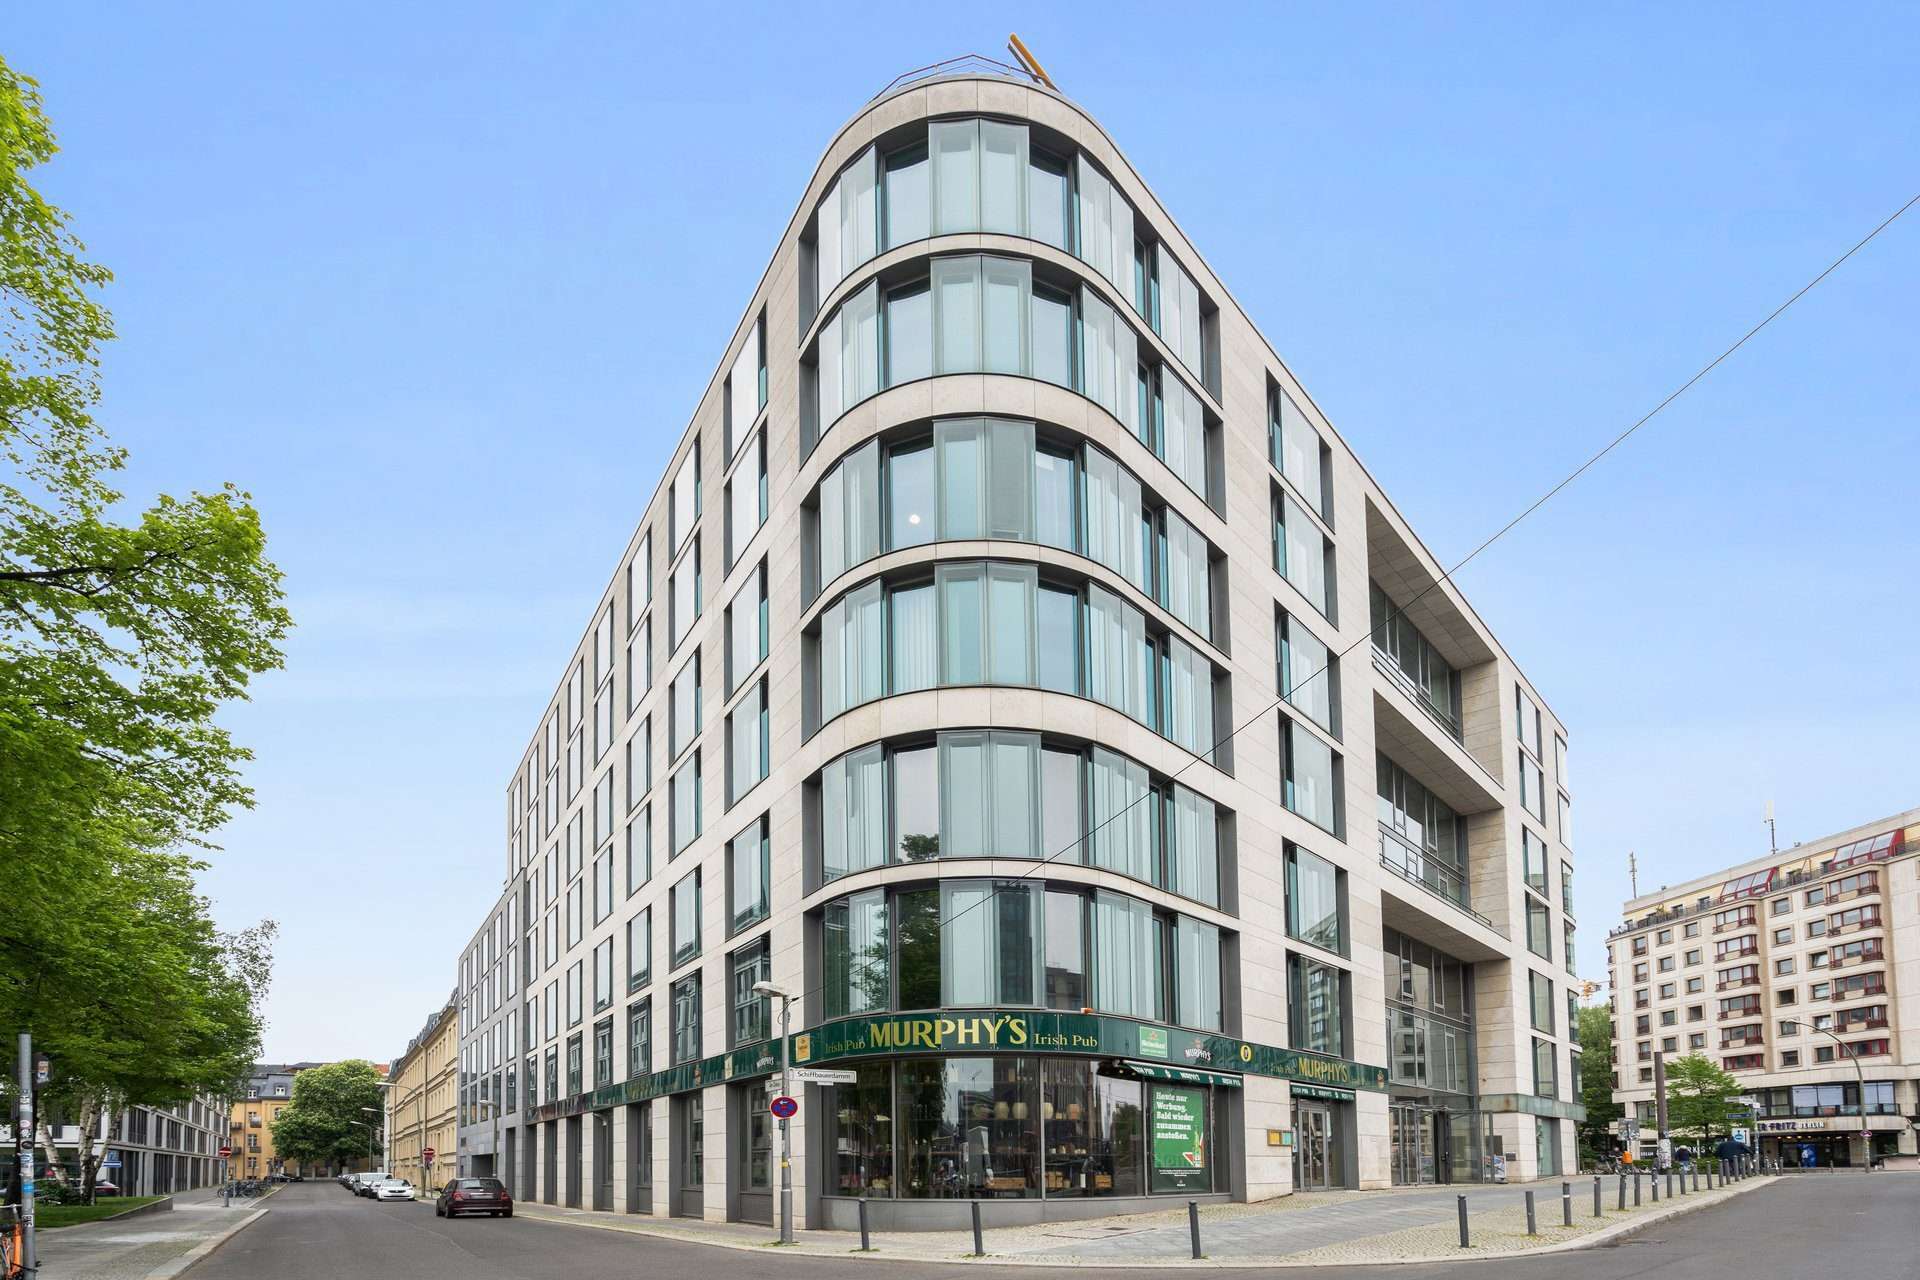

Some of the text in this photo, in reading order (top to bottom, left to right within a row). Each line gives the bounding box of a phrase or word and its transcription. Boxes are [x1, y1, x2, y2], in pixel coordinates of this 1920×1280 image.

[825, 1015, 1098, 1053] Irish Pub MURPHY'S Irish Pub
[1298, 1056, 1348, 1082] MURPHY'S
[1156, 1091, 1175, 1101] Heute
[1156, 1111, 1195, 1121] Bald wieder
[1156, 1122, 1192, 1131] zusammen
